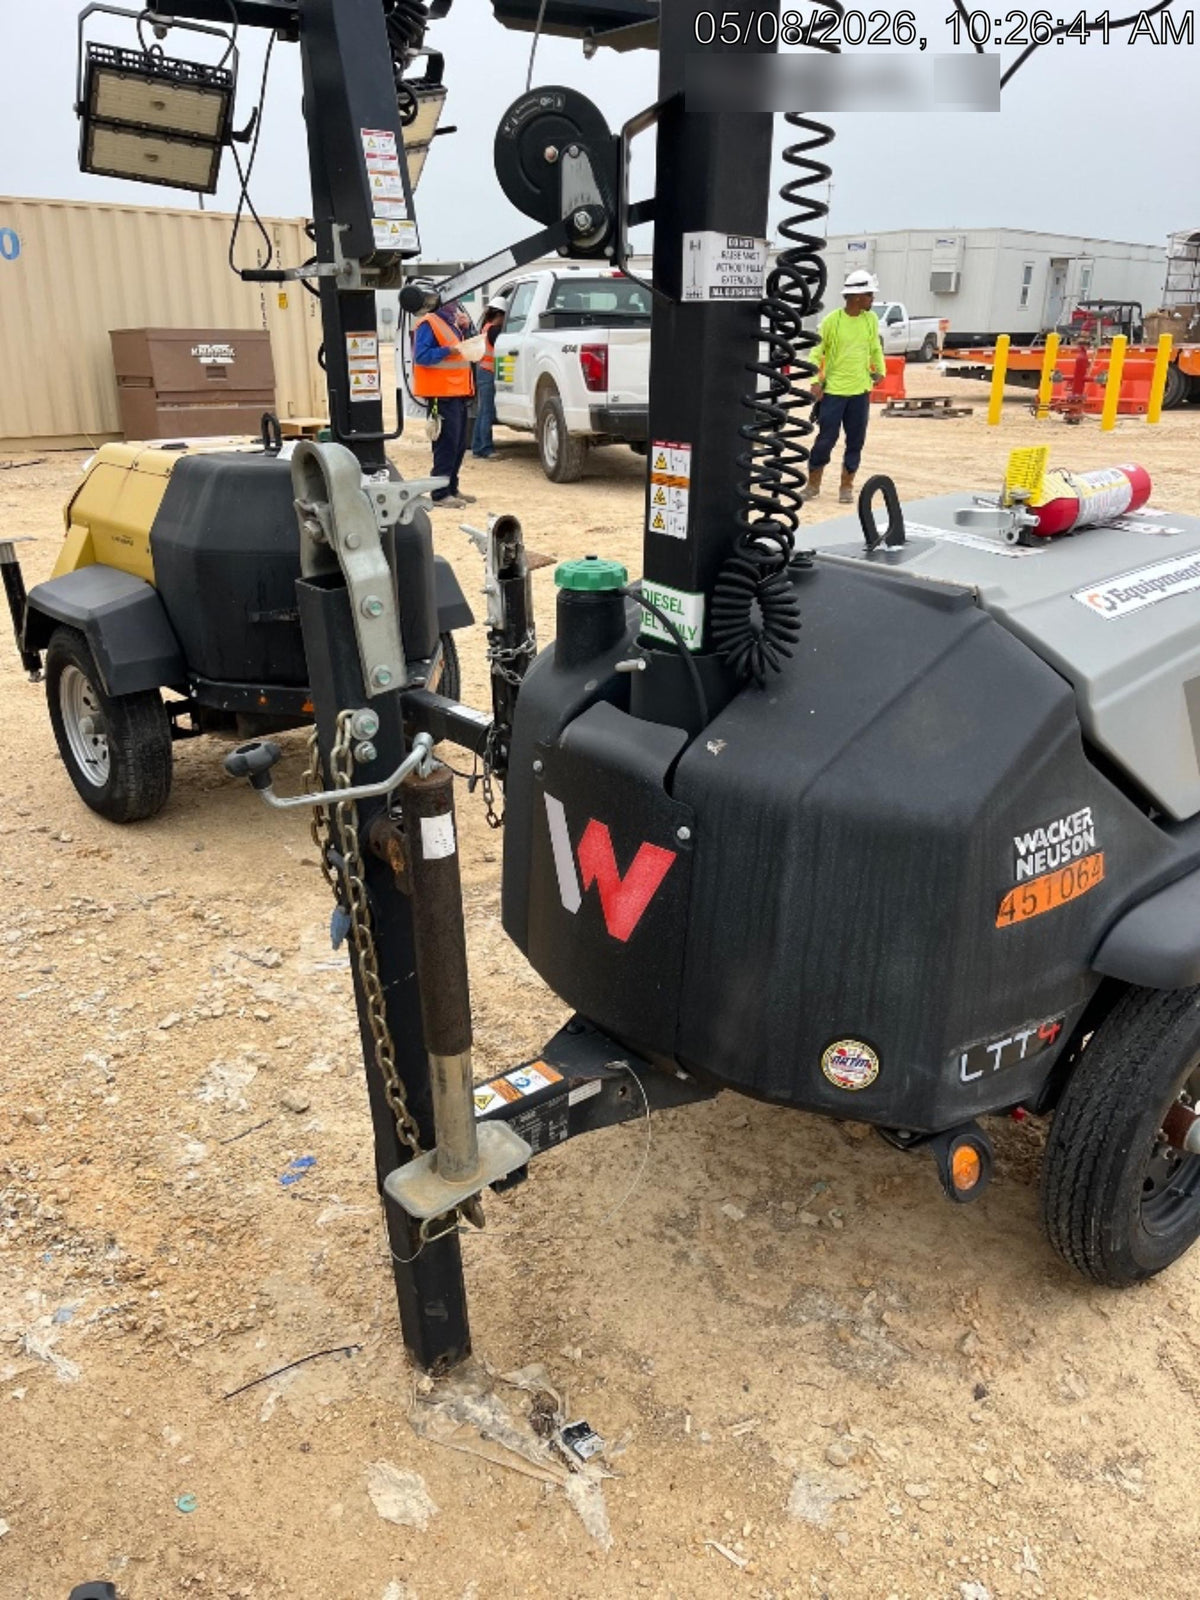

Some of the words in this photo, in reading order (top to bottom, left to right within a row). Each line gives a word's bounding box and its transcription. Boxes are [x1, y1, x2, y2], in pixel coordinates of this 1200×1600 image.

[641, 588, 685, 615] DIESEL
[1013, 806, 1095, 856] WACKER
[1016, 826, 1096, 881] NEUSON
